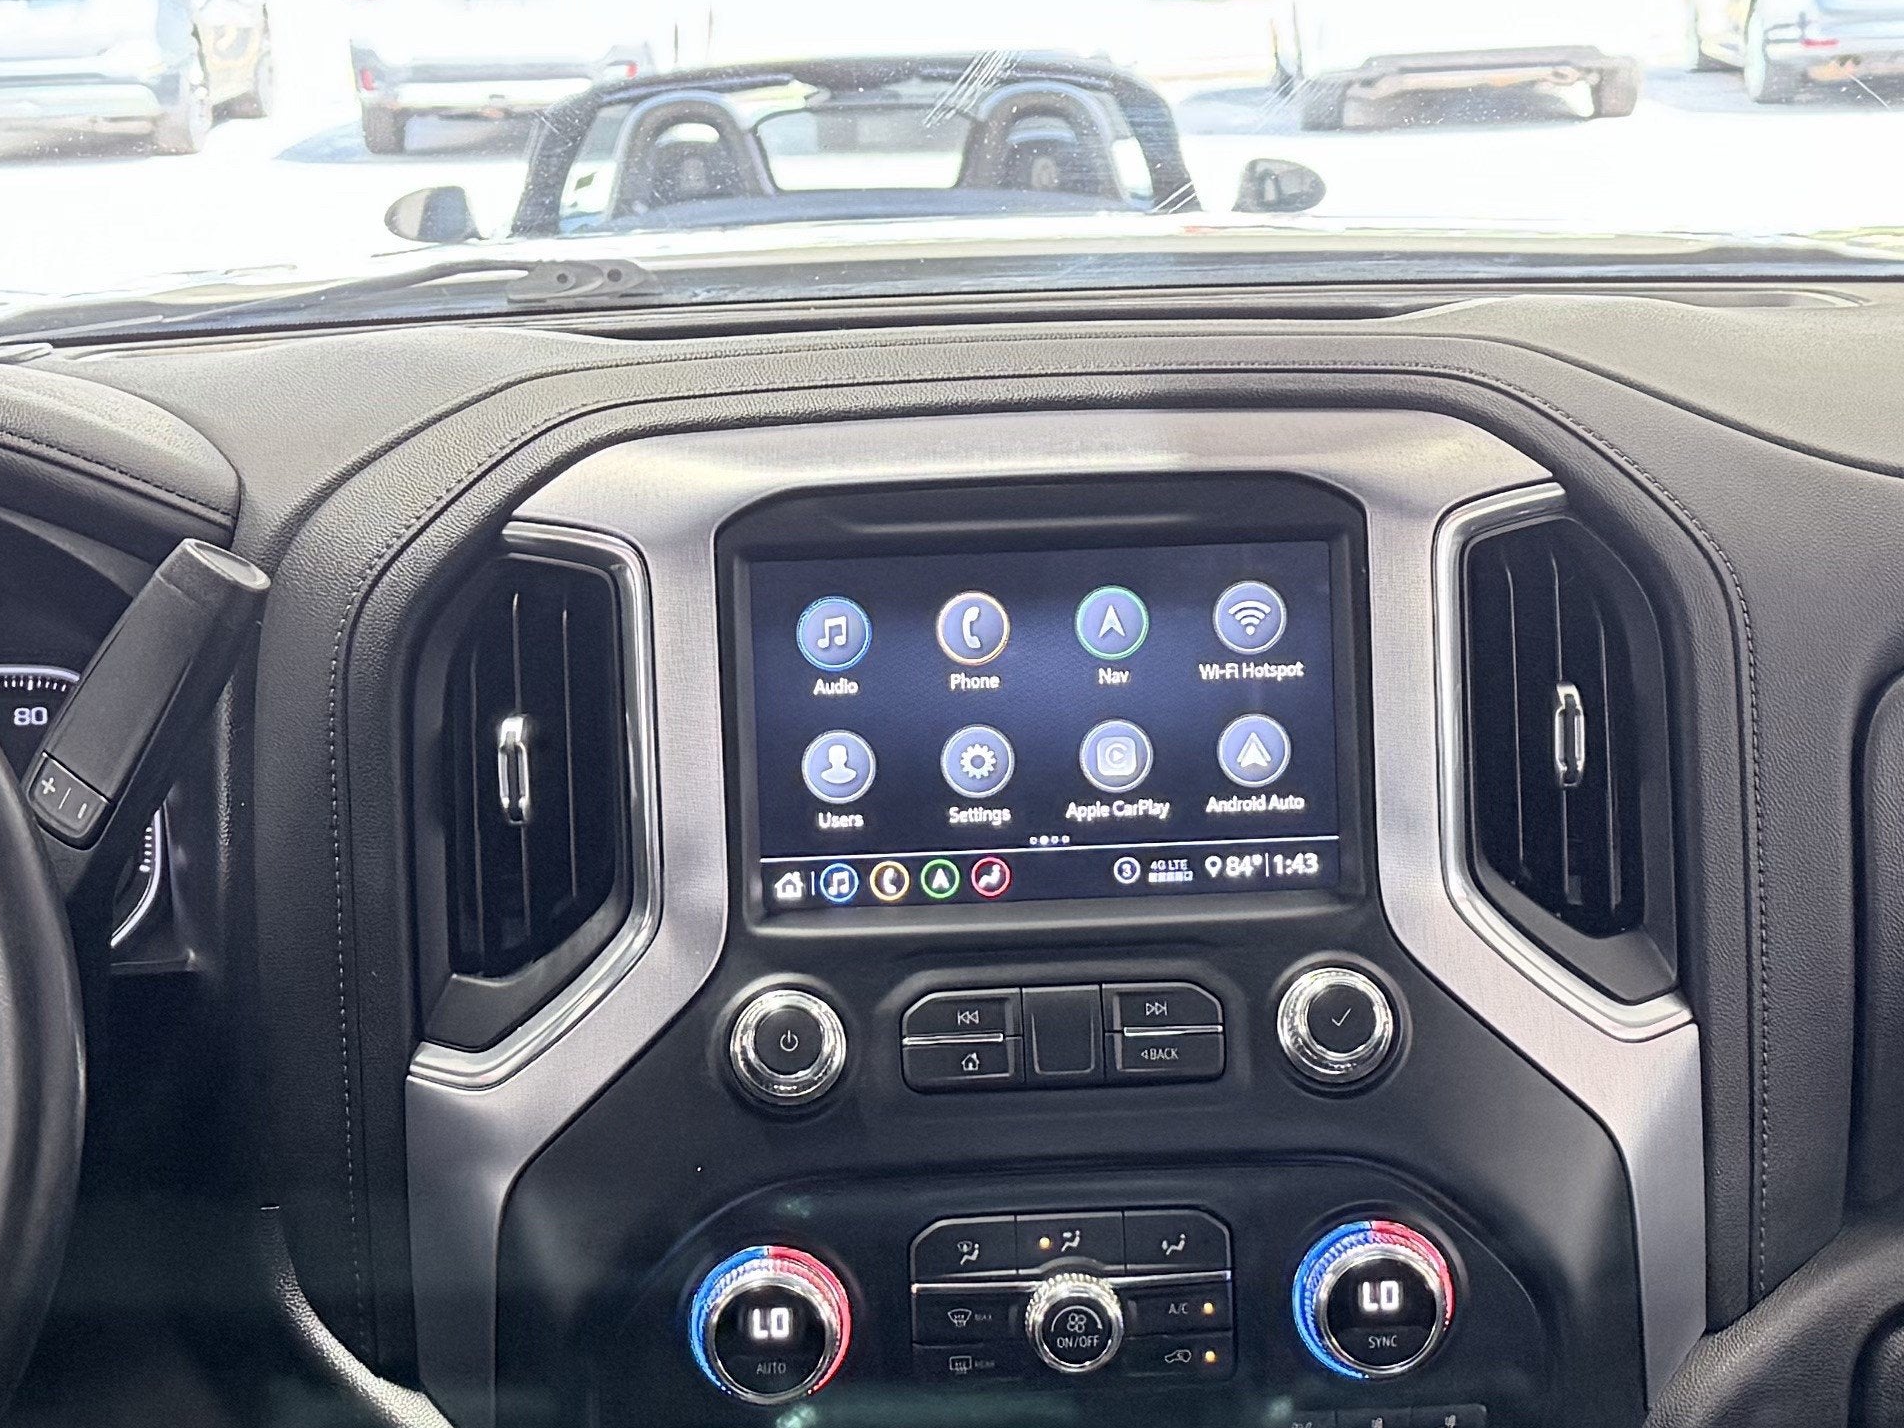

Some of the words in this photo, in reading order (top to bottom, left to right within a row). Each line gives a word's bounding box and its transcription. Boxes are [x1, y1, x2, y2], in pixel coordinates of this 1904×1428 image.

[1098, 667, 1131, 685] Nav
[1198, 663, 1239, 680] Wi-Fi
[1242, 661, 1305, 681] Hotspot
[812, 678, 859, 695] Audio
[950, 672, 1001, 691] Phone
[13, 706, 48, 726] 80
[1065, 802, 1110, 821] Apple
[1112, 799, 1171, 820] CarPlay
[1205, 795, 1266, 813] Android
[1268, 794, 1305, 810] Auto
[818, 812, 864, 829] Users
[948, 806, 1012, 826] Settings
[1168, 859, 1189, 870] LTE
[1272, 853, 1319, 875] 1:43
[1149, 1047, 1179, 1061] BACK
[1168, 1303, 1189, 1315] A/C
[1056, 1335, 1101, 1350] ON/OFF
[1368, 1335, 1398, 1349] SYNC
[756, 1362, 787, 1375] AUTO
